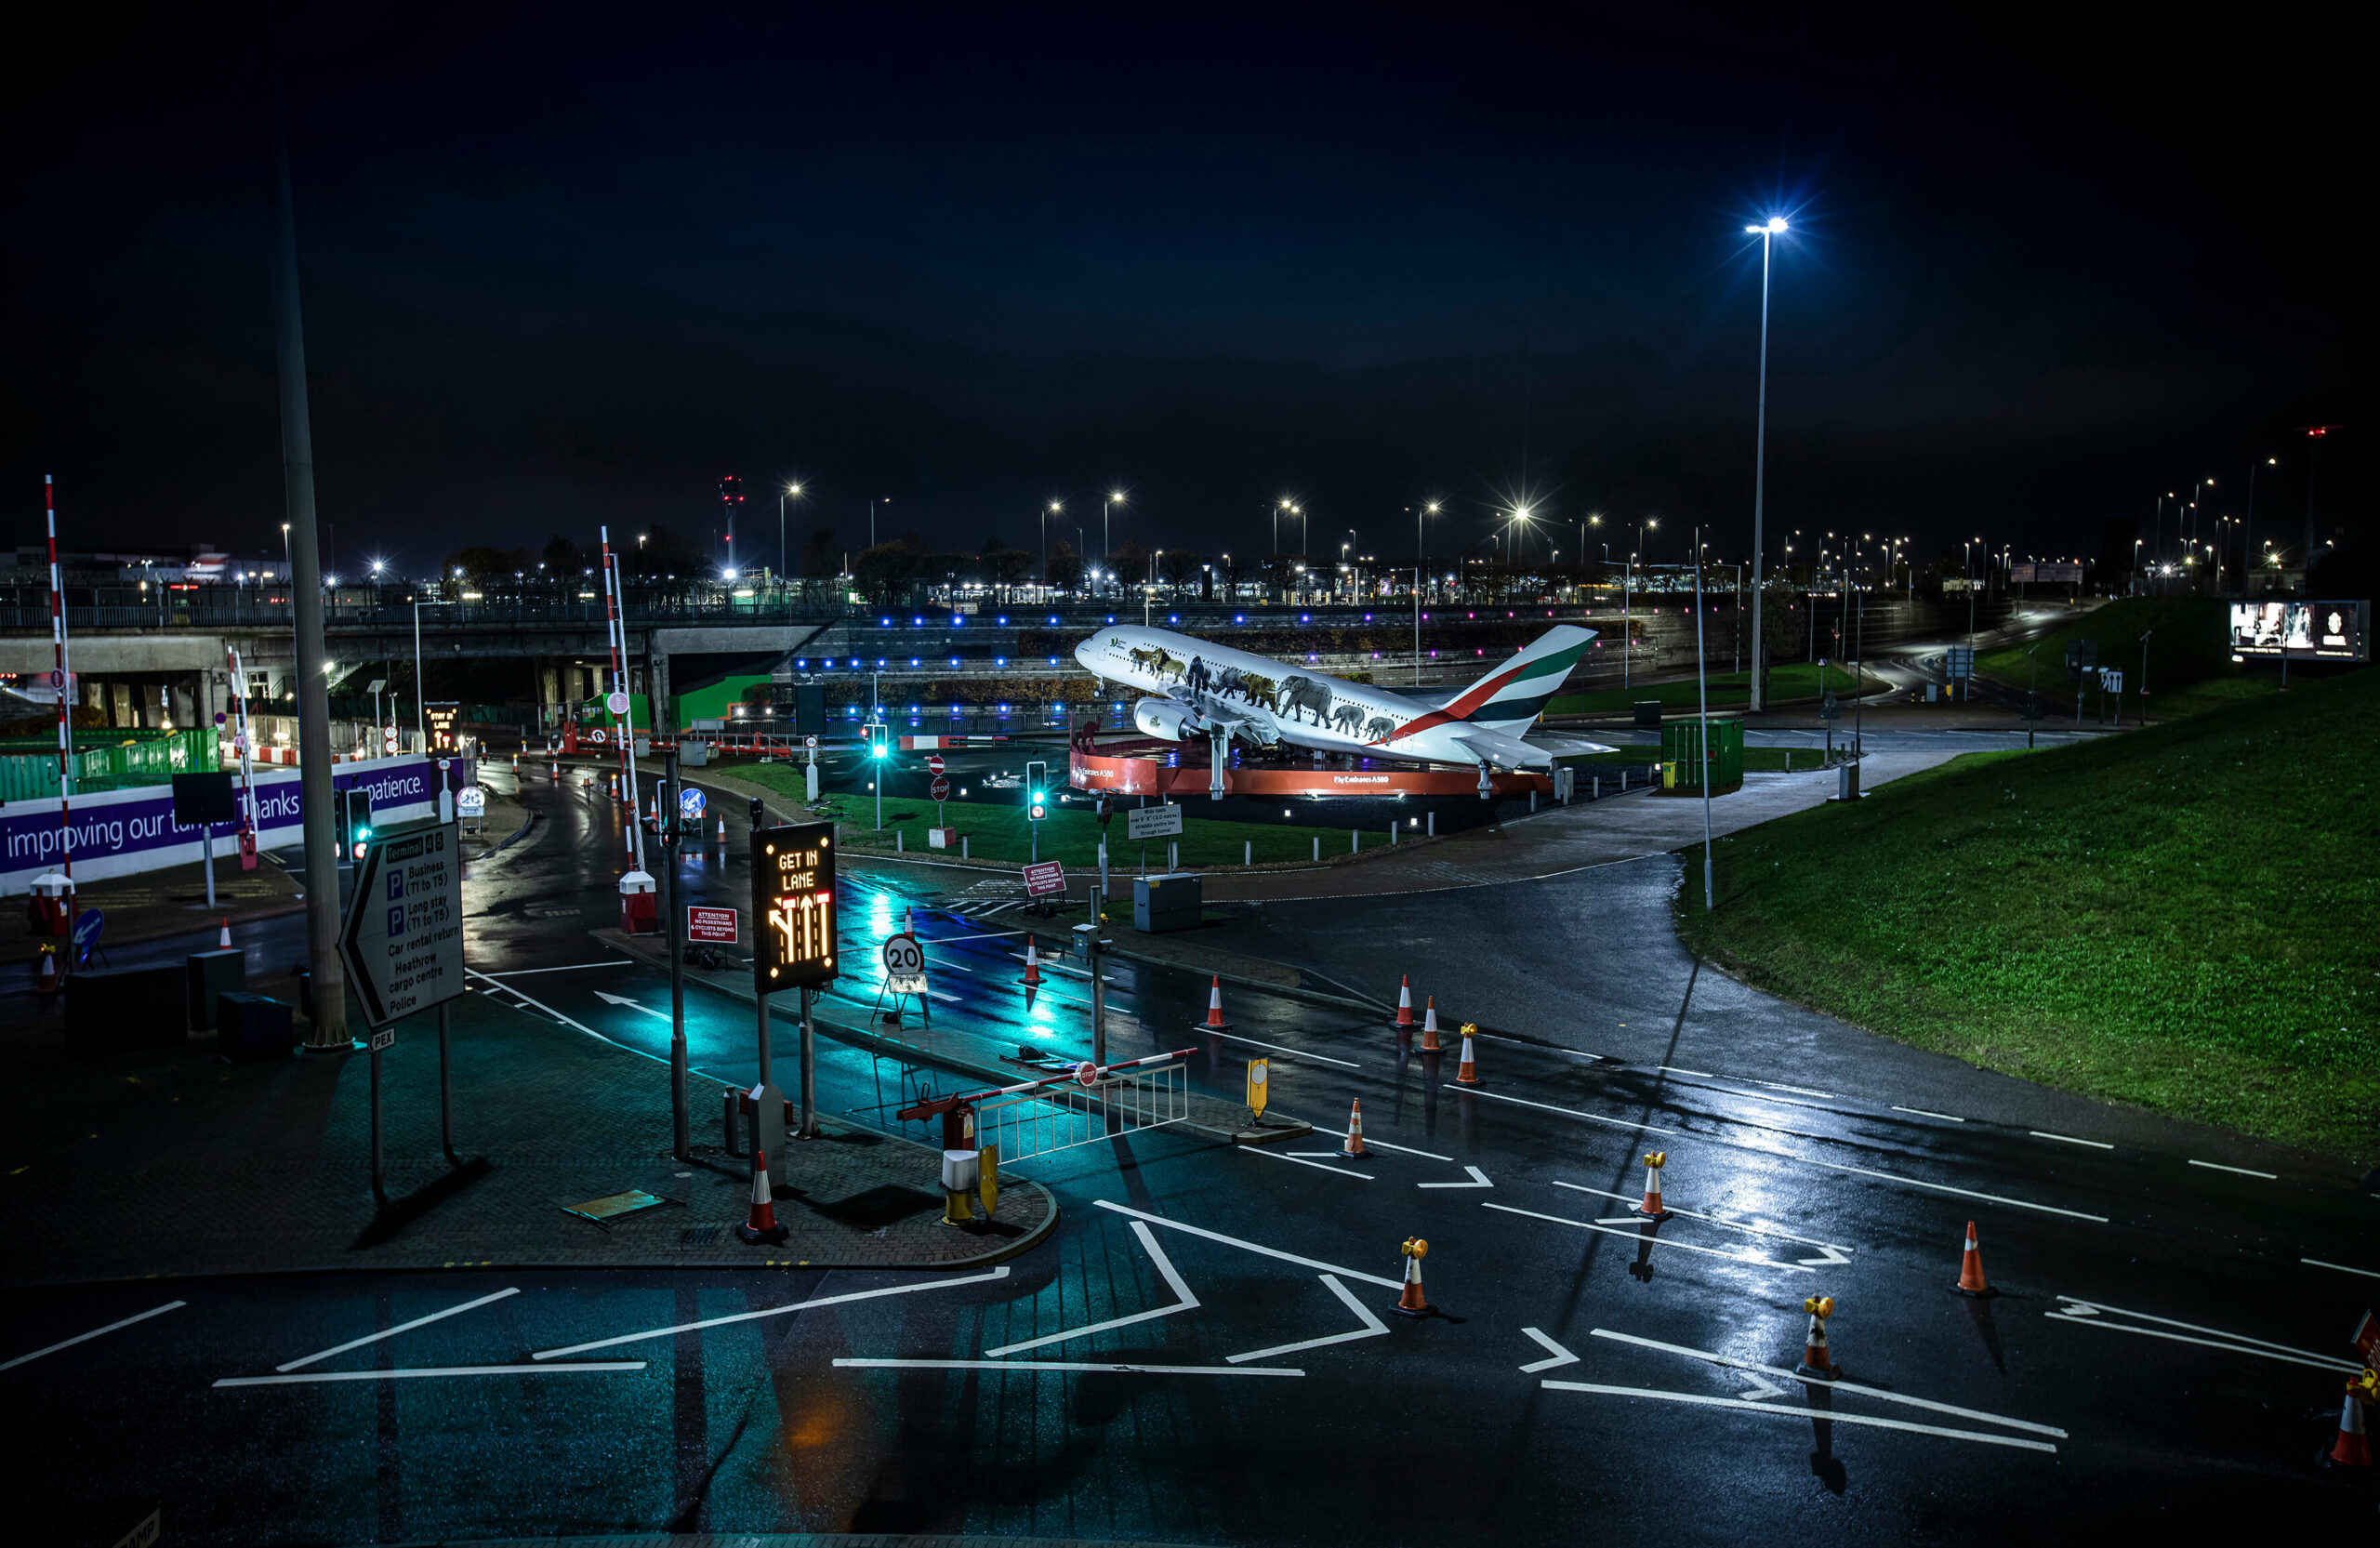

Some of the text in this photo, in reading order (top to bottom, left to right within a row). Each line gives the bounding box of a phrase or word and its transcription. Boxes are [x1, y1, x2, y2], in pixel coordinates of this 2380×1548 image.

[434, 721, 450, 730] LANE
[1083, 767, 1099, 775] Emirates
[1100, 769, 1114, 778] A380
[1333, 775, 1344, 784] Fly
[1372, 775, 1389, 784] A380
[932, 785, 948, 794] STOP
[7, 816, 123, 861] improving
[129, 812, 165, 840] our
[366, 774, 424, 801] patience.
[387, 834, 443, 861] Terminal 4 5
[409, 861, 444, 879] Business
[779, 850, 817, 870] GET IN
[390, 872, 402, 898] P
[406, 871, 448, 896] (T1 to T5)
[783, 871, 813, 891] LANE
[409, 895, 447, 915] Long stay
[390, 907, 403, 933] P
[406, 906, 450, 933] (T1 to T5)
[388, 927, 458, 957] Car rental return
[395, 953, 437, 975] Heathrow
[889, 947, 918, 968] 20
[389, 967, 443, 993] cargo centre
[390, 996, 416, 1013] Police
[375, 1032, 391, 1048] PEX
[1081, 1070, 1095, 1078] STOP
